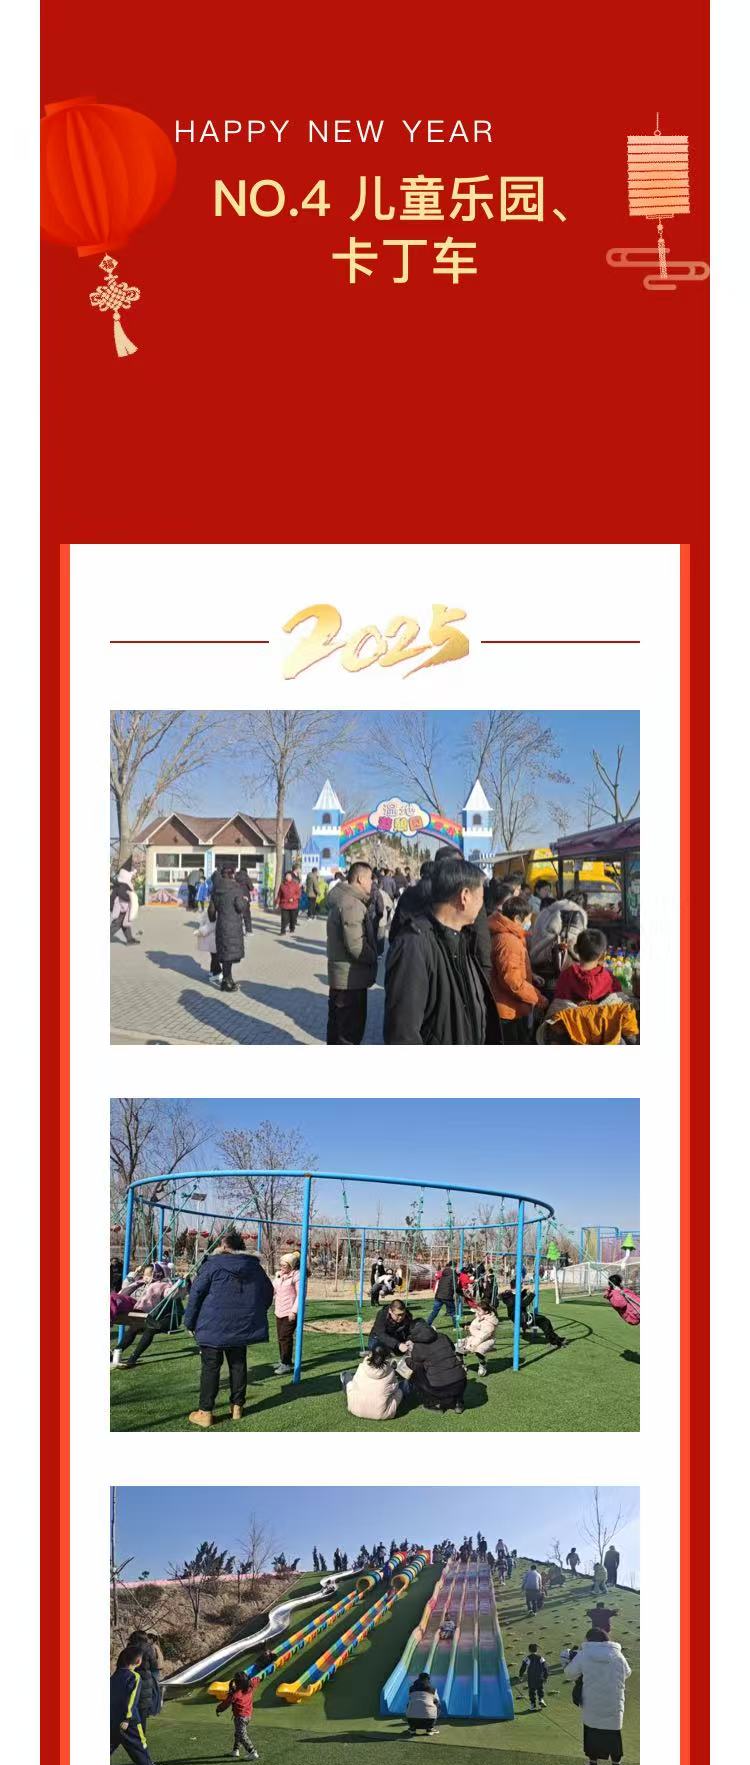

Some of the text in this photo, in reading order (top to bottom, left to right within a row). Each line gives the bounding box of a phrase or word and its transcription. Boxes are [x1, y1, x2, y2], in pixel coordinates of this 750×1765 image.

[175, 120, 493, 143] HAPPY NEW YEAR
[214, 173, 567, 223] NO.4 儿童乐园、
[331, 235, 478, 285] 卡丁车
[281, 603, 471, 681] 2025
